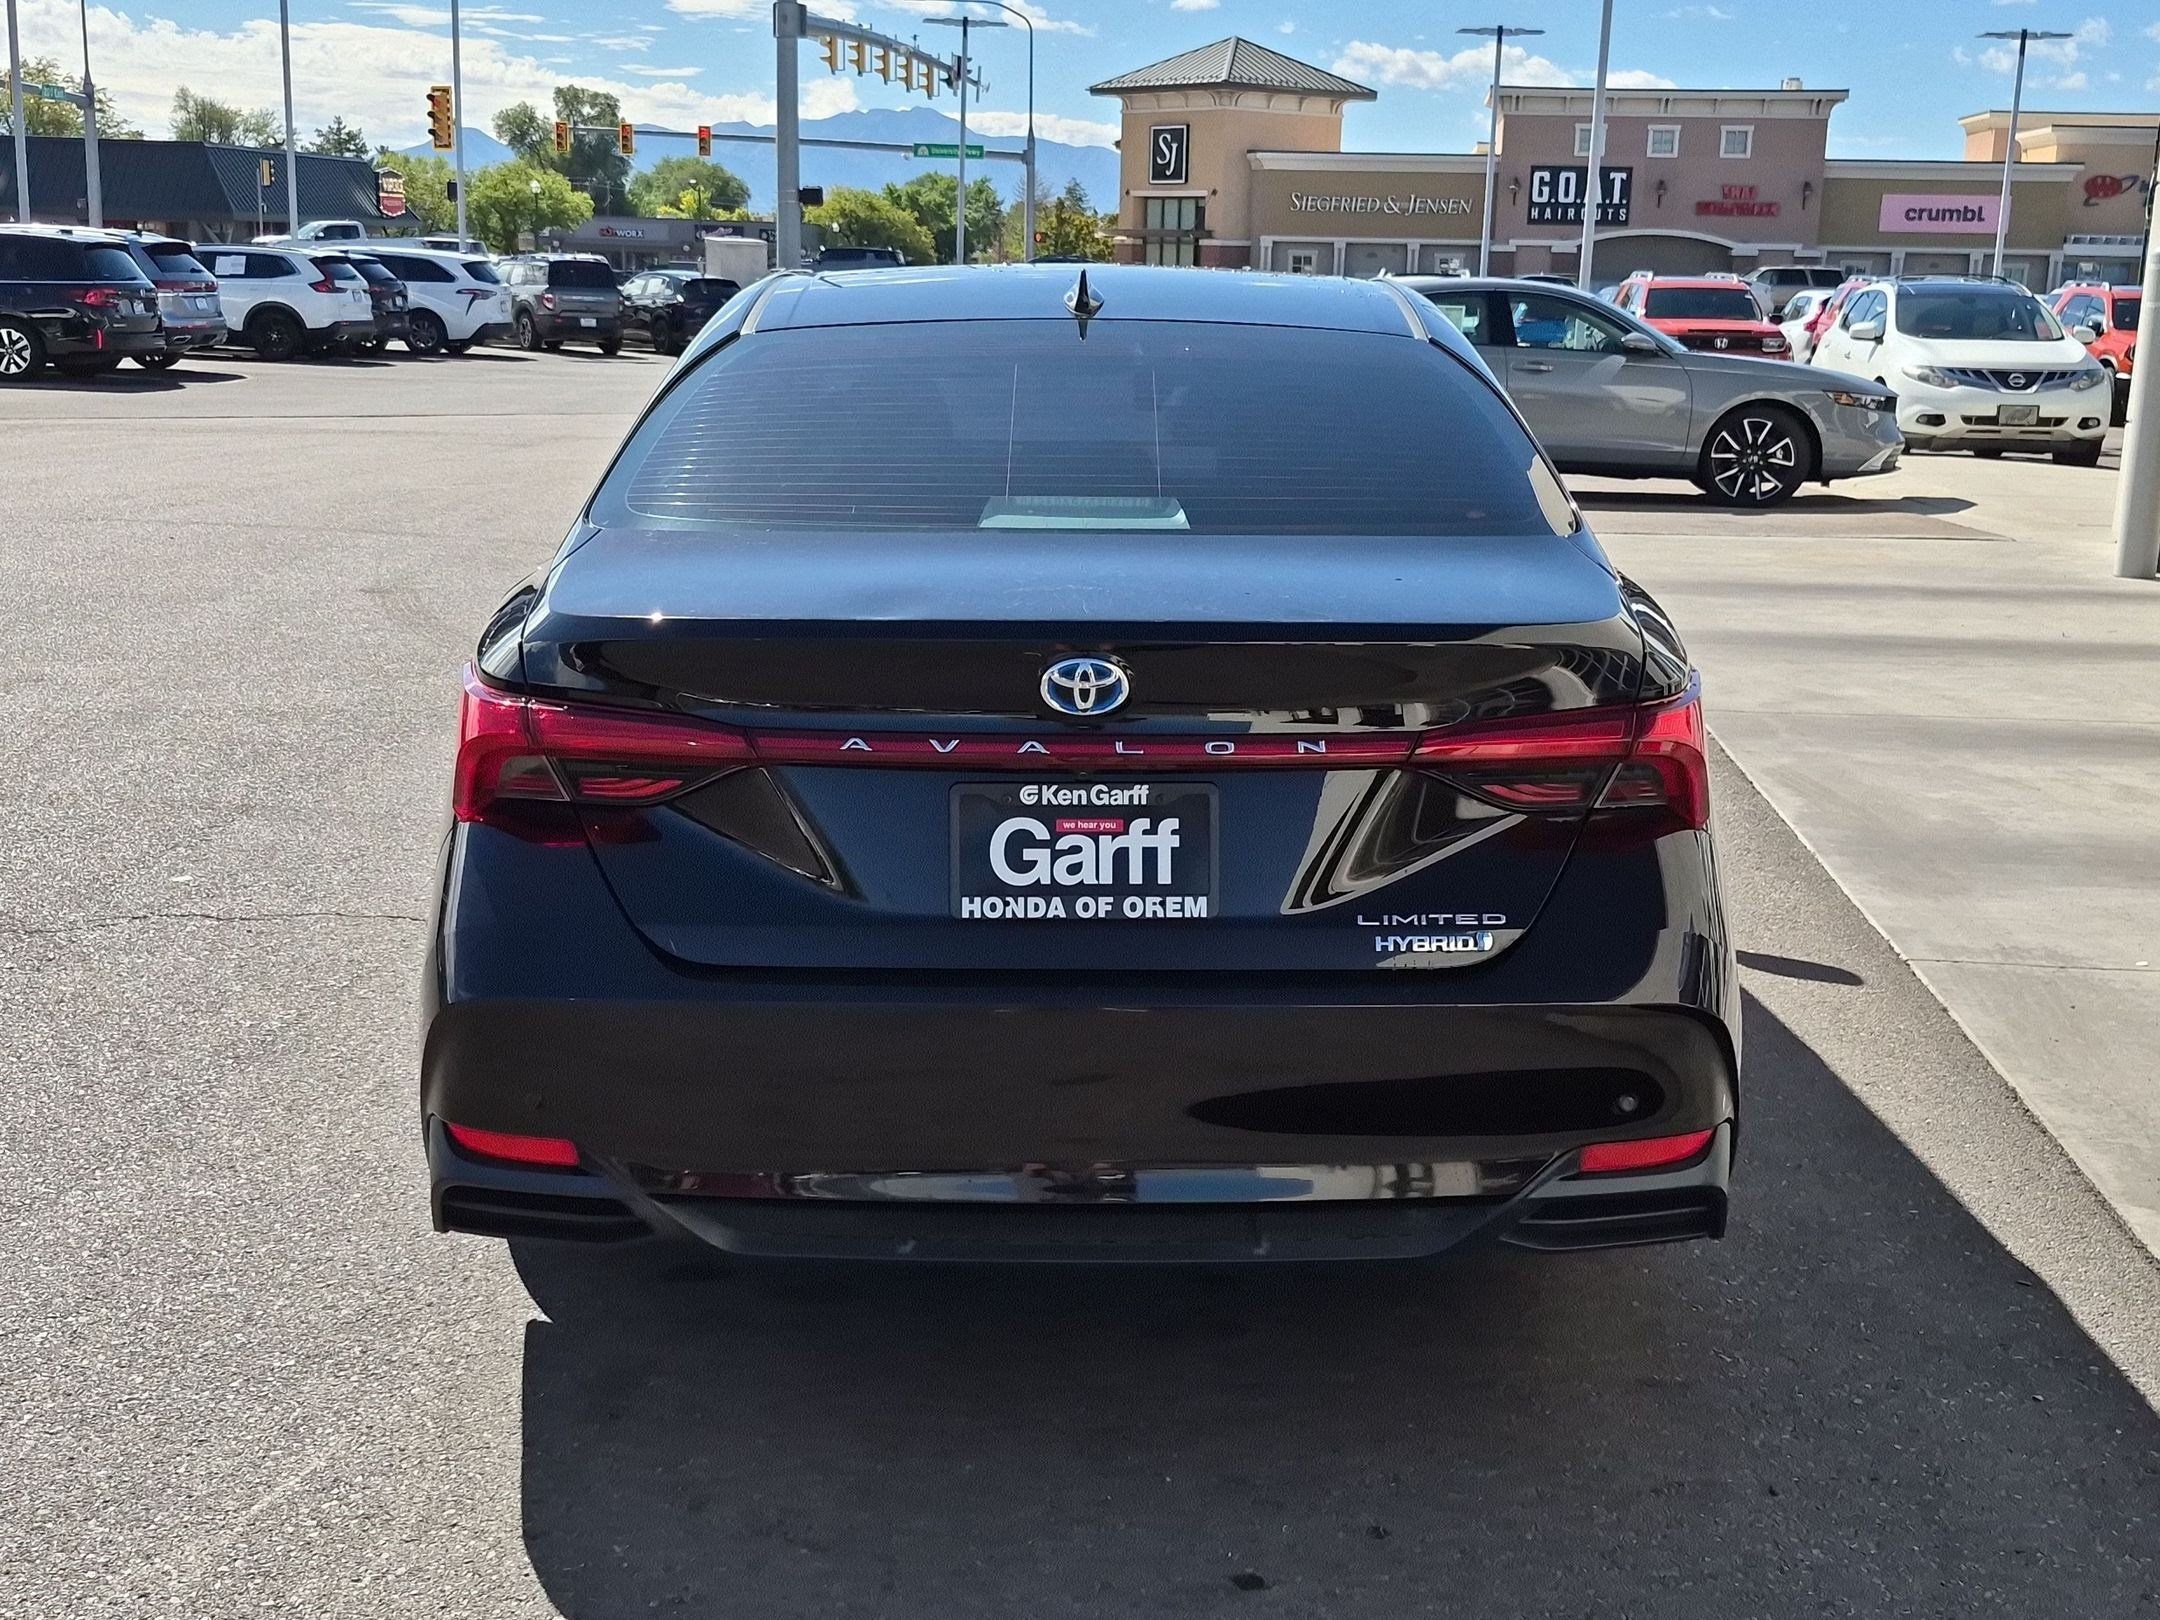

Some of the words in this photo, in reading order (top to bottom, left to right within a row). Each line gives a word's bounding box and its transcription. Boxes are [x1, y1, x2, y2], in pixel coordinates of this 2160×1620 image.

[1156, 133, 1179, 176] SJ
[1289, 192, 1380, 213] SIEGFRIED
[1384, 195, 1401, 214] &
[1405, 194, 1472, 216] JENSEN
[1904, 205, 1985, 222] crumbl
[840, 737, 1327, 754] AVALON
[1041, 785, 1088, 806] Ken
[1090, 784, 1149, 806] Garff
[1078, 821, 1099, 829] hear
[1099, 822, 1117, 831] you
[989, 816, 1180, 886] Garff
[961, 896, 1067, 919] HONDA
[1075, 896, 1114, 919] OF
[1122, 896, 1208, 919] OREM
[1357, 914, 1507, 926] LIMITED
[1375, 935, 1476, 952] HYBRID
